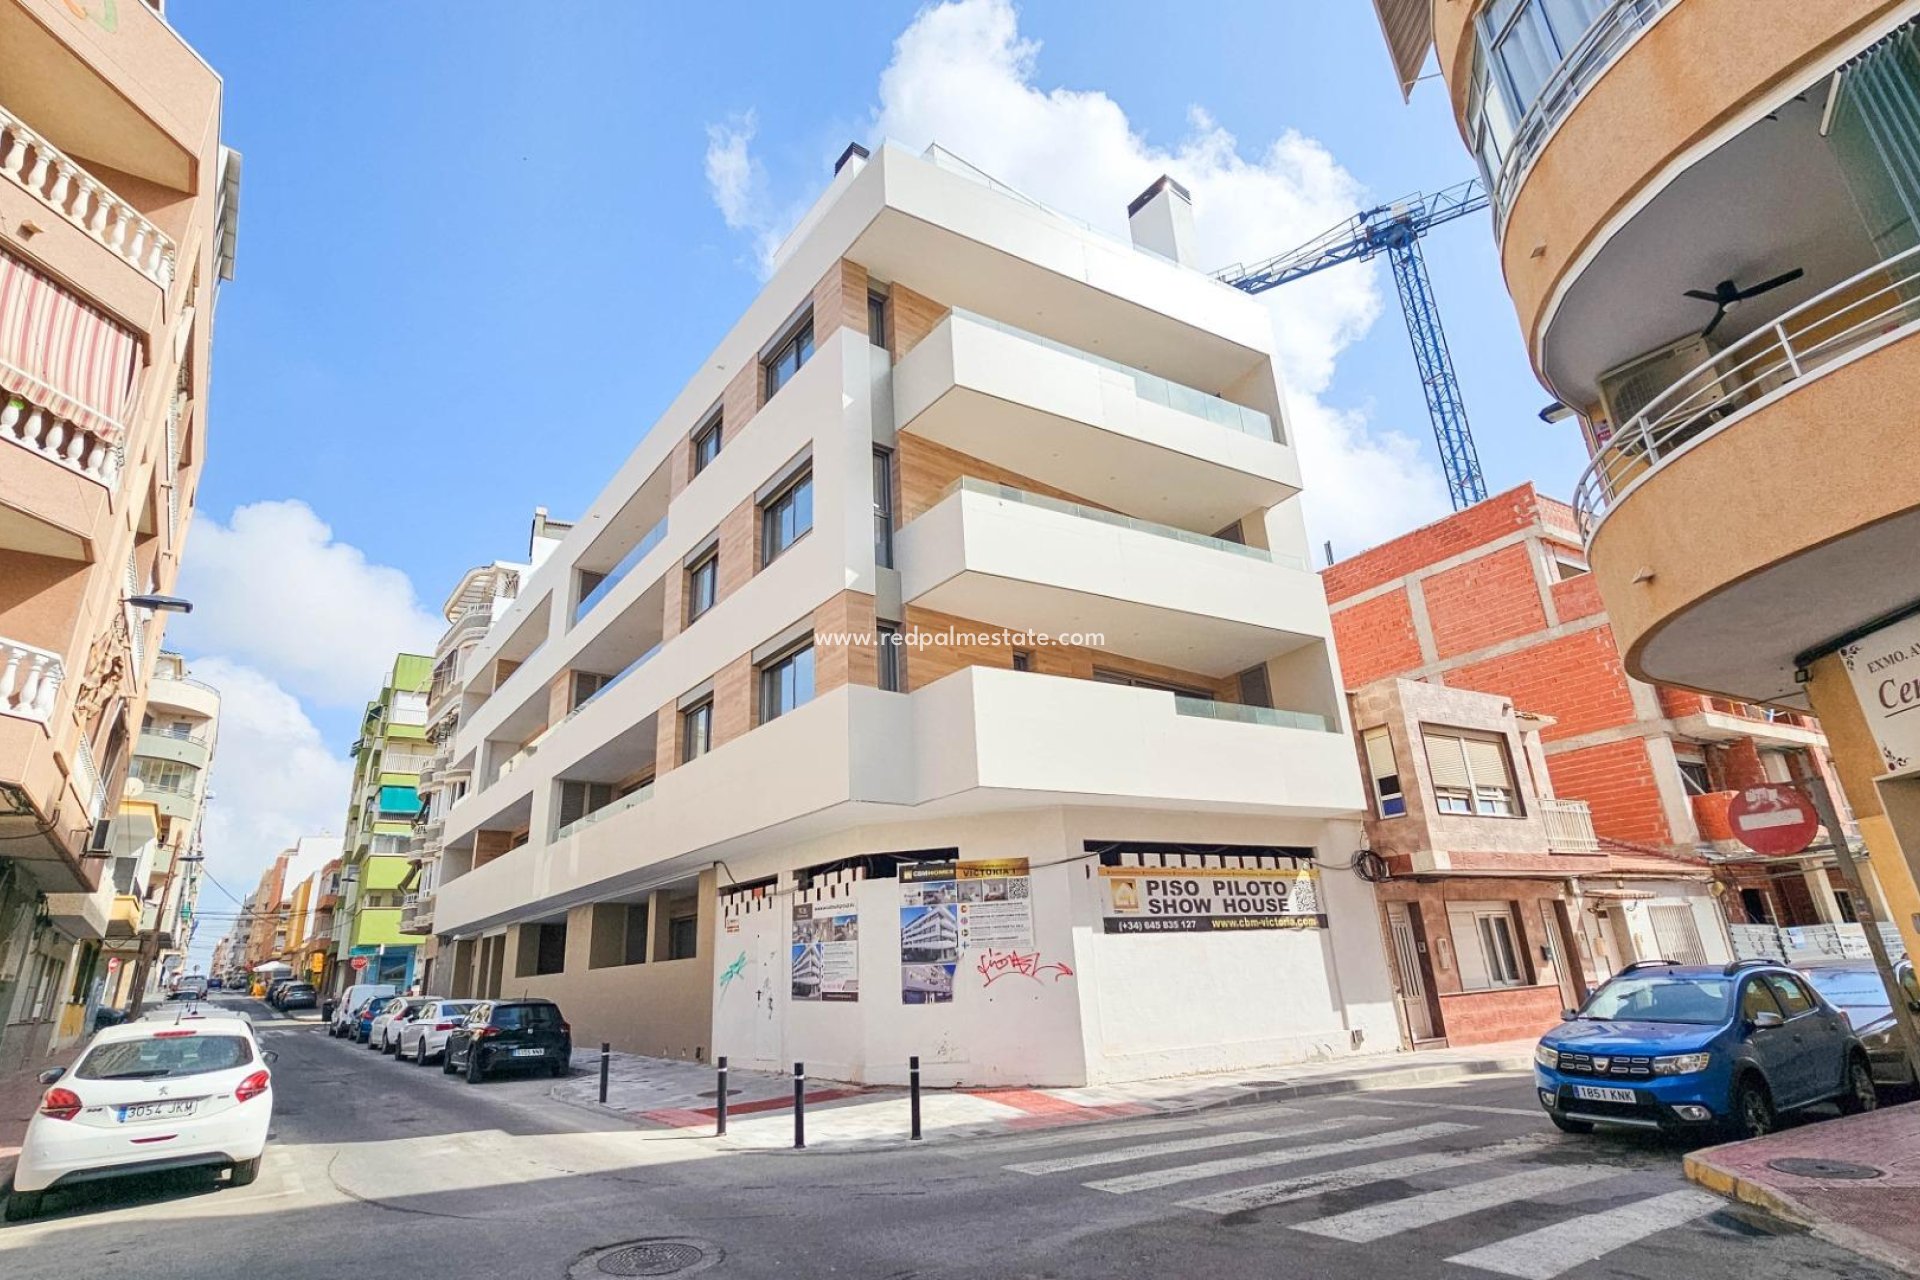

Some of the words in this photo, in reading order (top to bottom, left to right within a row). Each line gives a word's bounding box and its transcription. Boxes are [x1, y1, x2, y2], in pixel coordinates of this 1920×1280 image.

[1867, 650, 1908, 674] EXMO.
[963, 867, 1009, 877] VICTORIA
[1146, 880, 1200, 896] PISO
[1213, 880, 1287, 896] PILOTO
[1148, 898, 1211, 914] SHOW
[1223, 898, 1290, 913] HOUSE
[1118, 921, 1142, 931] (+34)
[1181, 920, 1196, 929] 127
[1212, 917, 1317, 928] www.cbm-victoria.com
[1582, 1087, 1606, 1098] 1851
[1610, 1090, 1633, 1101] KNK
[128, 1104, 162, 1118] 3054
[168, 1101, 193, 1113] JKM
